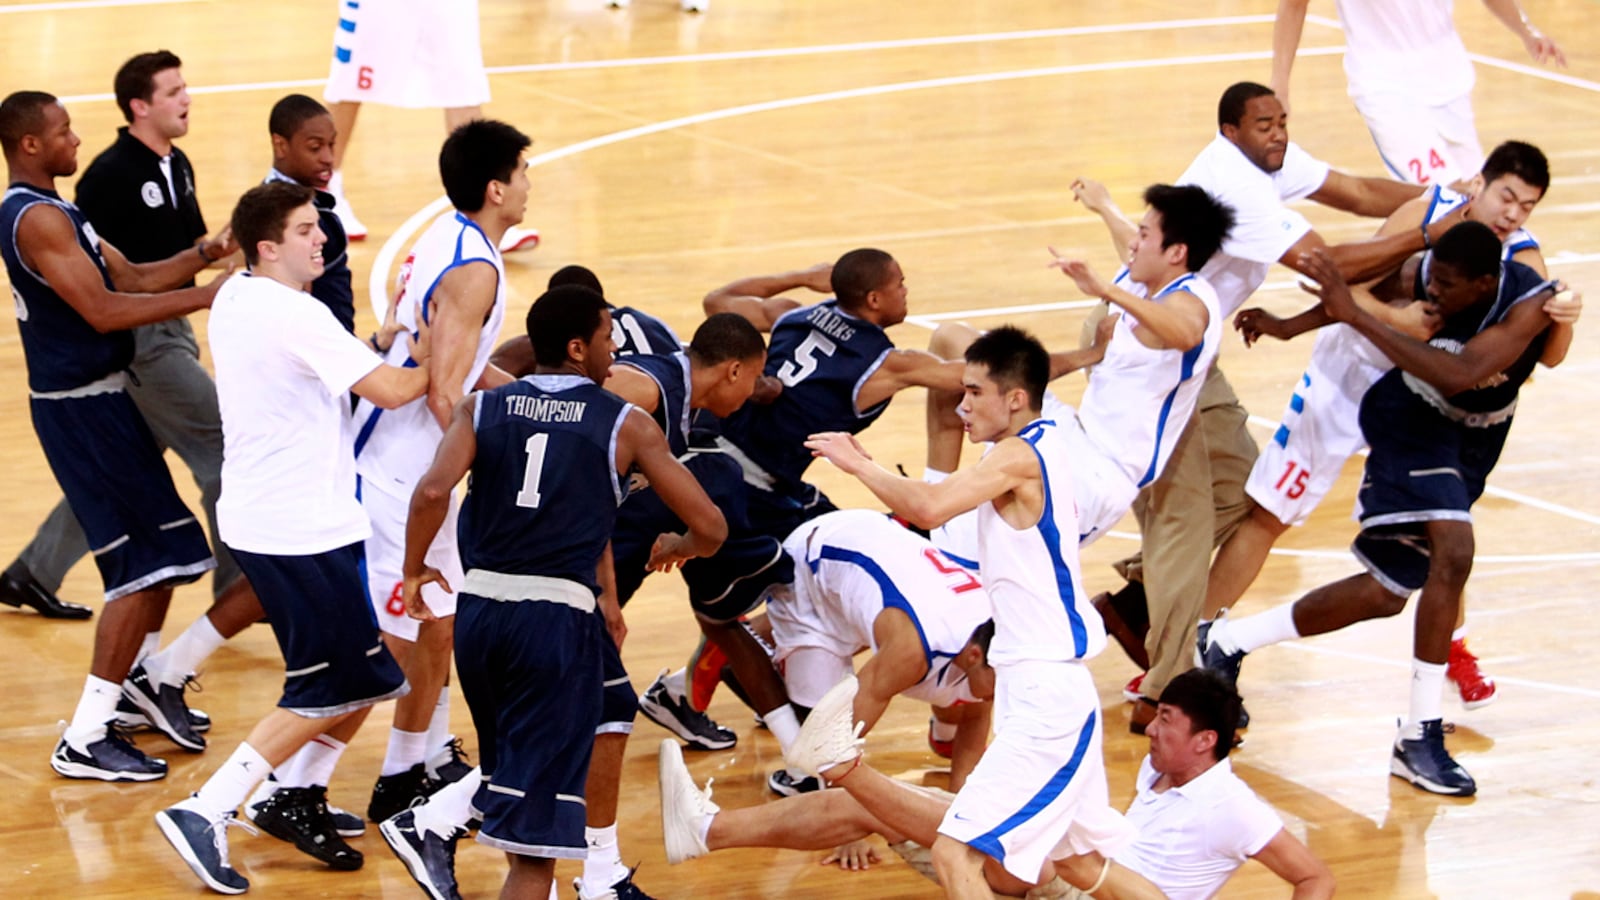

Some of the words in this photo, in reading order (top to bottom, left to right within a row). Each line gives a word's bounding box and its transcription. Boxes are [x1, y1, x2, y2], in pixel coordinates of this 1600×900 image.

[358, 66, 373, 90] 6
[1408, 148, 1446, 184] 24
[806, 305, 856, 342] STARKS
[777, 329, 837, 387] 5
[505, 395, 587, 422] THOMPSON
[516, 432, 549, 508] 1
[1275, 461, 1310, 500] 15
